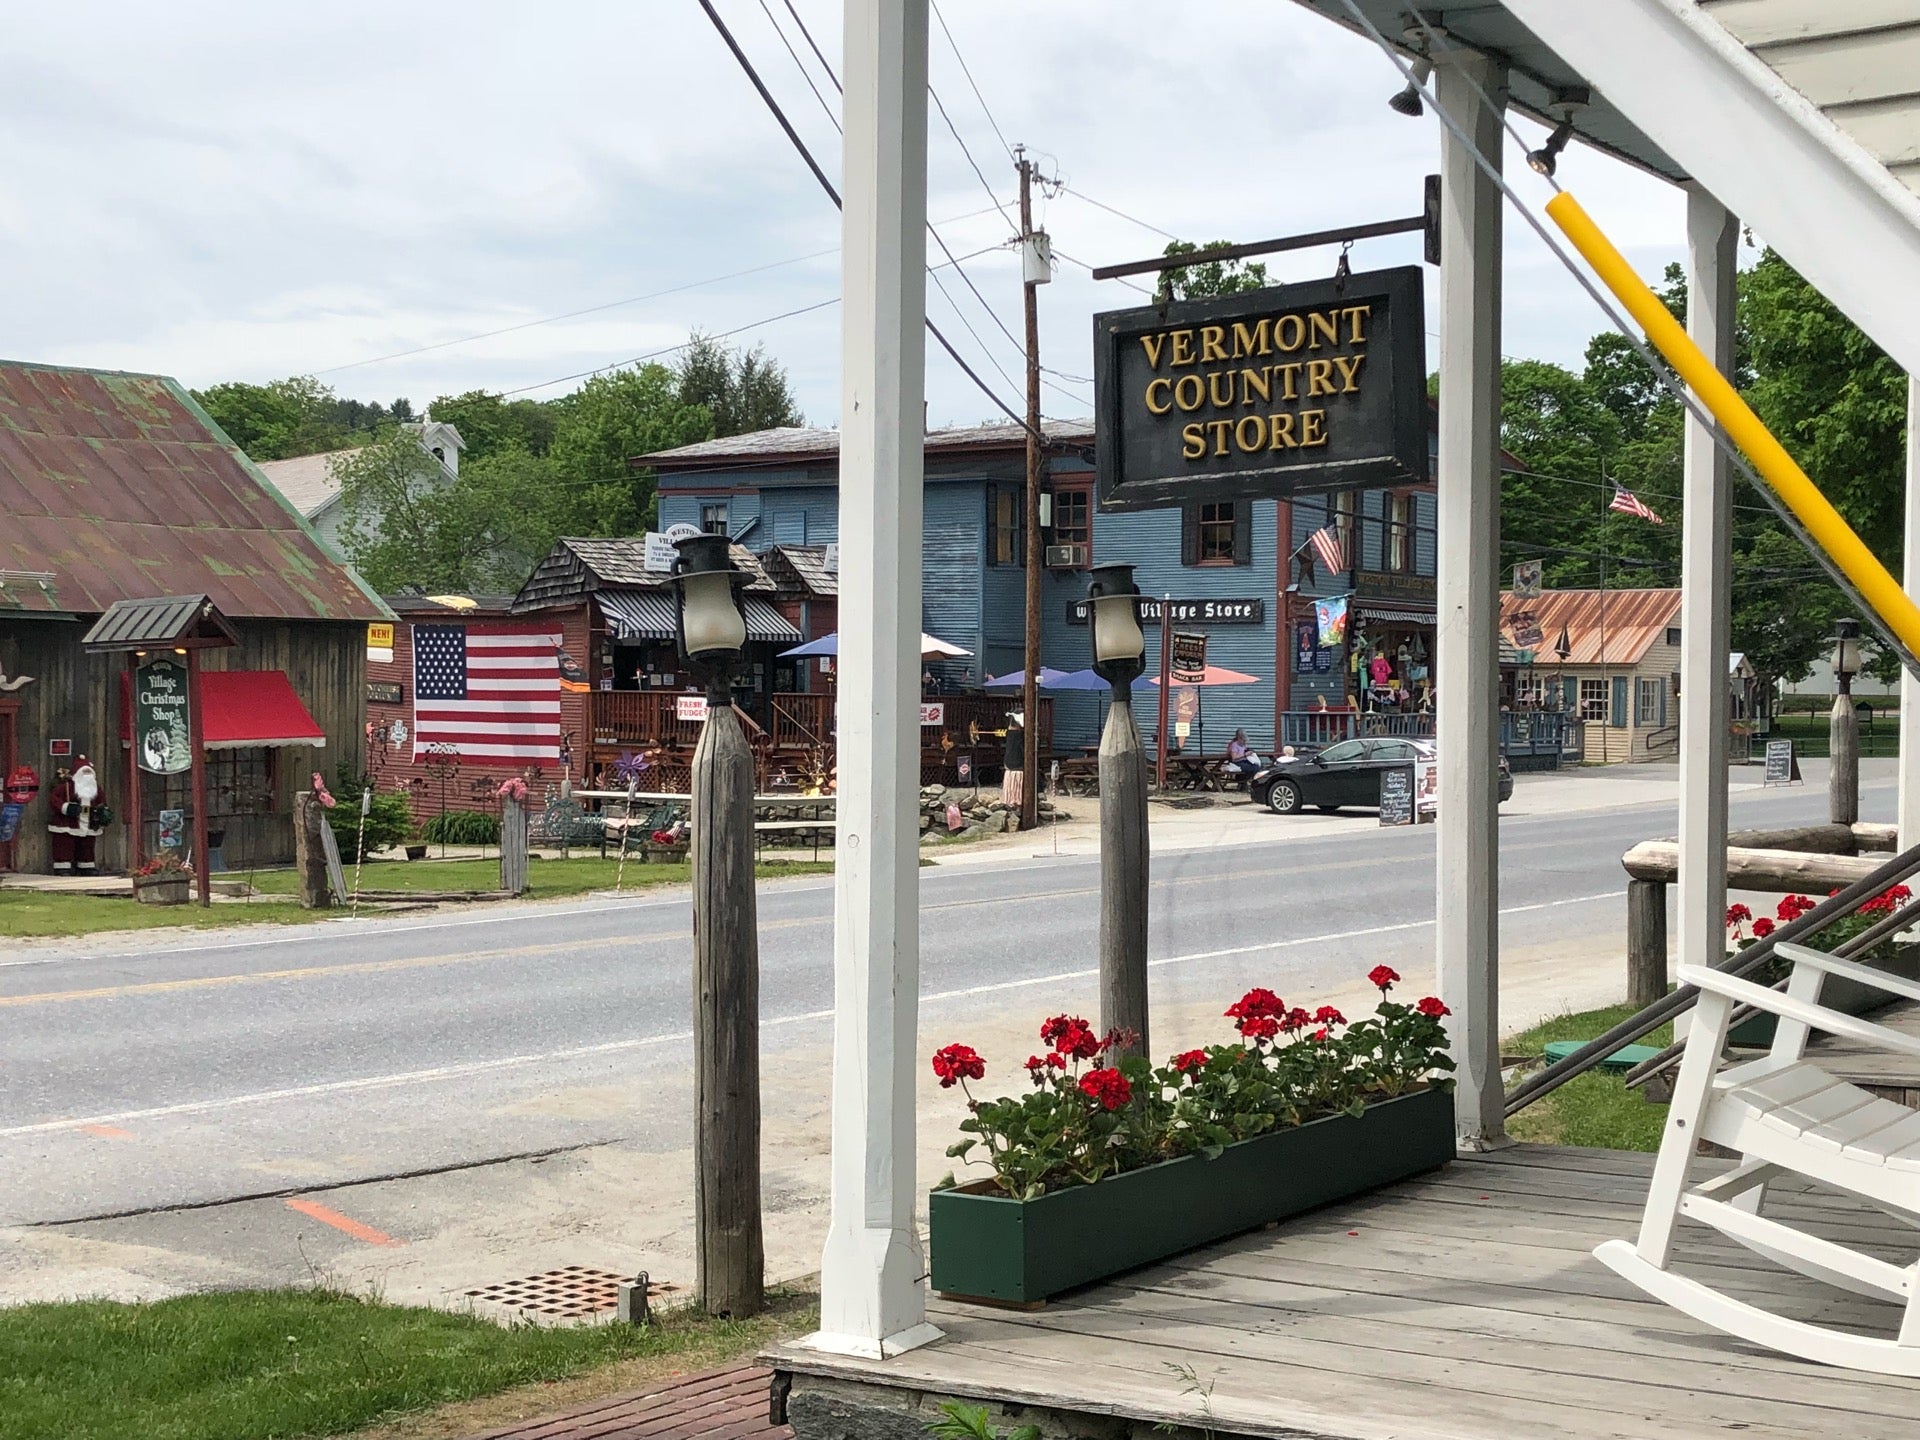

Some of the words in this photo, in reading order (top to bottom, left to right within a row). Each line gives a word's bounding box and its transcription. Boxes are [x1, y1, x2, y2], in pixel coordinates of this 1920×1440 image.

[1139, 305, 1371, 370] VERMONT
[1144, 354, 1366, 415] COUNTRY
[1182, 409, 1328, 460] STORE
[1140, 602, 1197, 620] Vilge
[1204, 602, 1251, 619] Store
[371, 628, 390, 639] NEHI
[148, 674, 177, 693] Village
[141, 691, 186, 706] Christmas
[679, 700, 703, 708] FRESH
[152, 706, 175, 727] Shop
[679, 709, 704, 717] FUDGE
